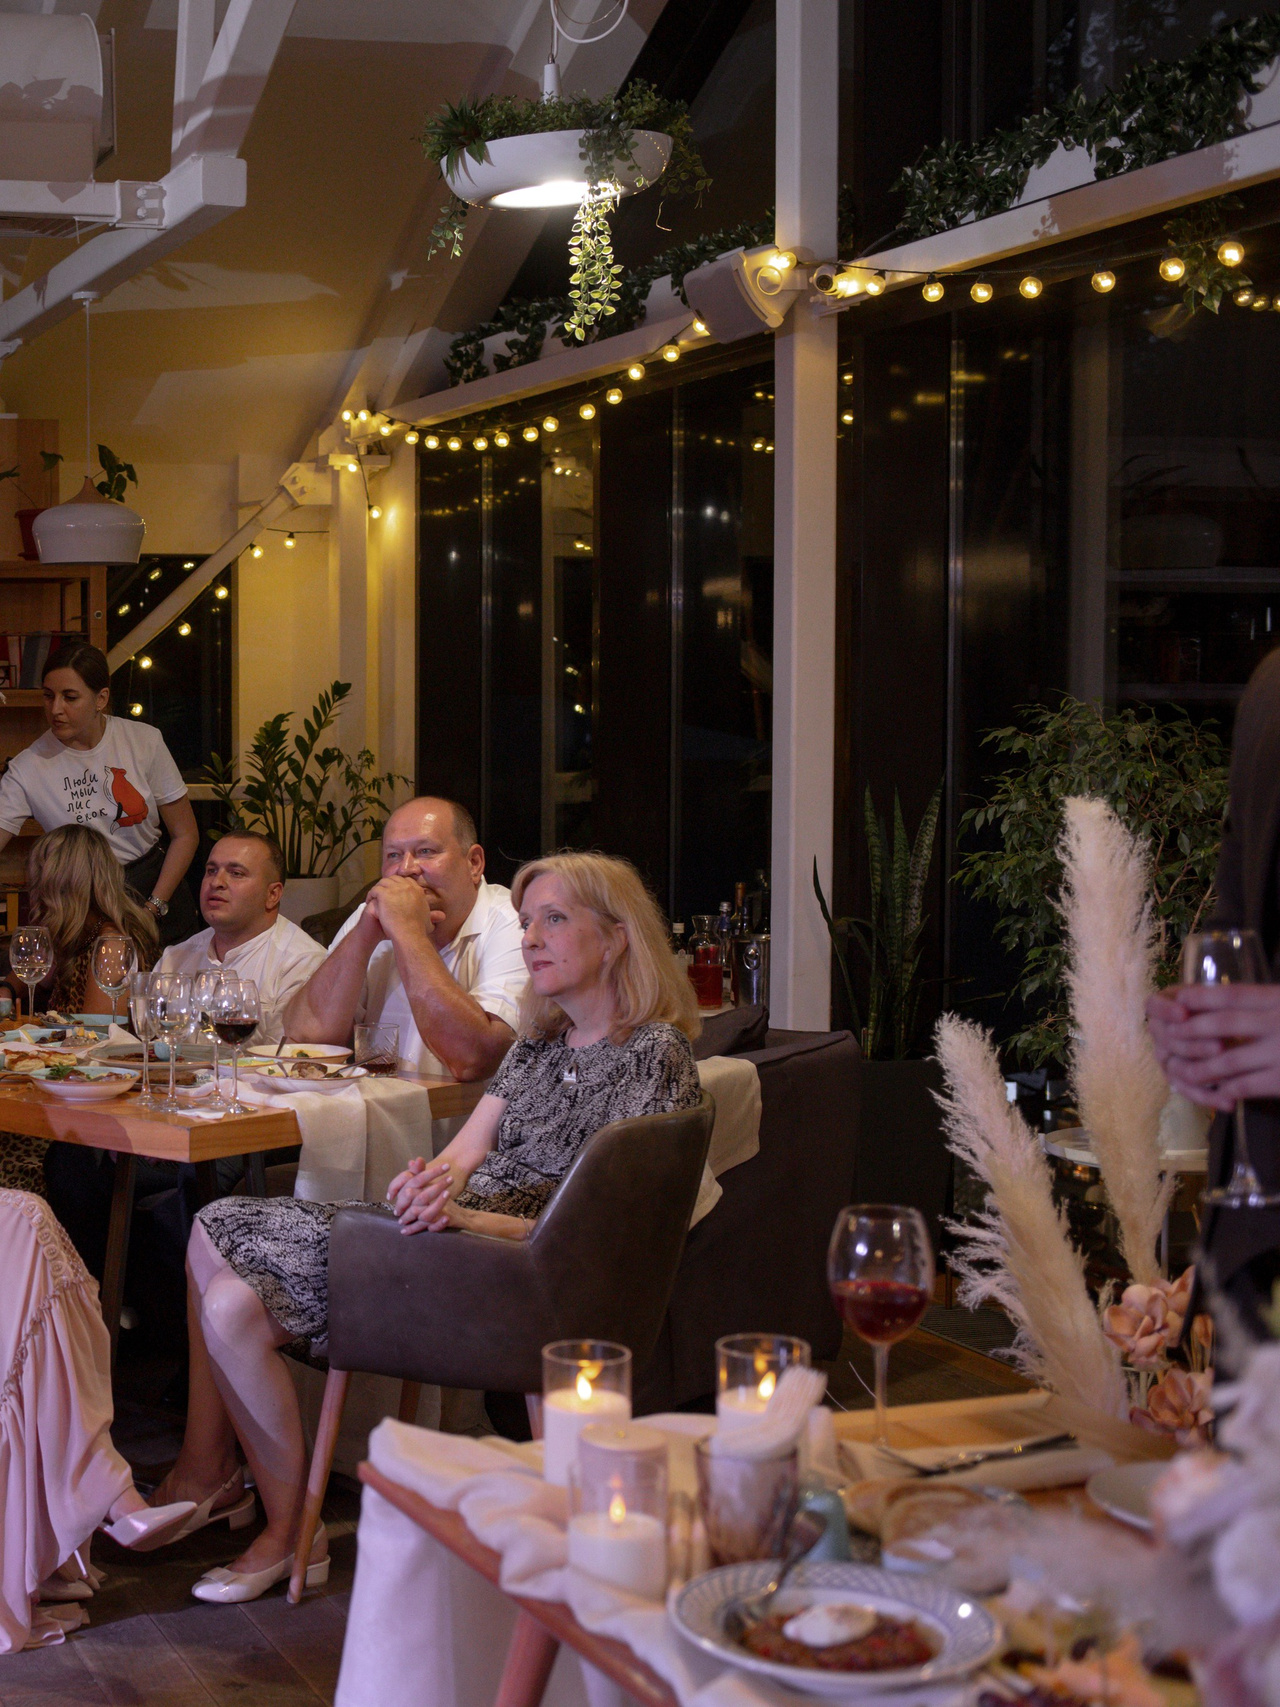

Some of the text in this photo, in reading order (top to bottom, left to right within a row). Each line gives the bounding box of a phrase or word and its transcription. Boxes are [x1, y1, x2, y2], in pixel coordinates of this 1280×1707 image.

[63, 769, 98, 791] Люби
[70, 783, 98, 800] мый
[67, 799, 91, 812] лис
